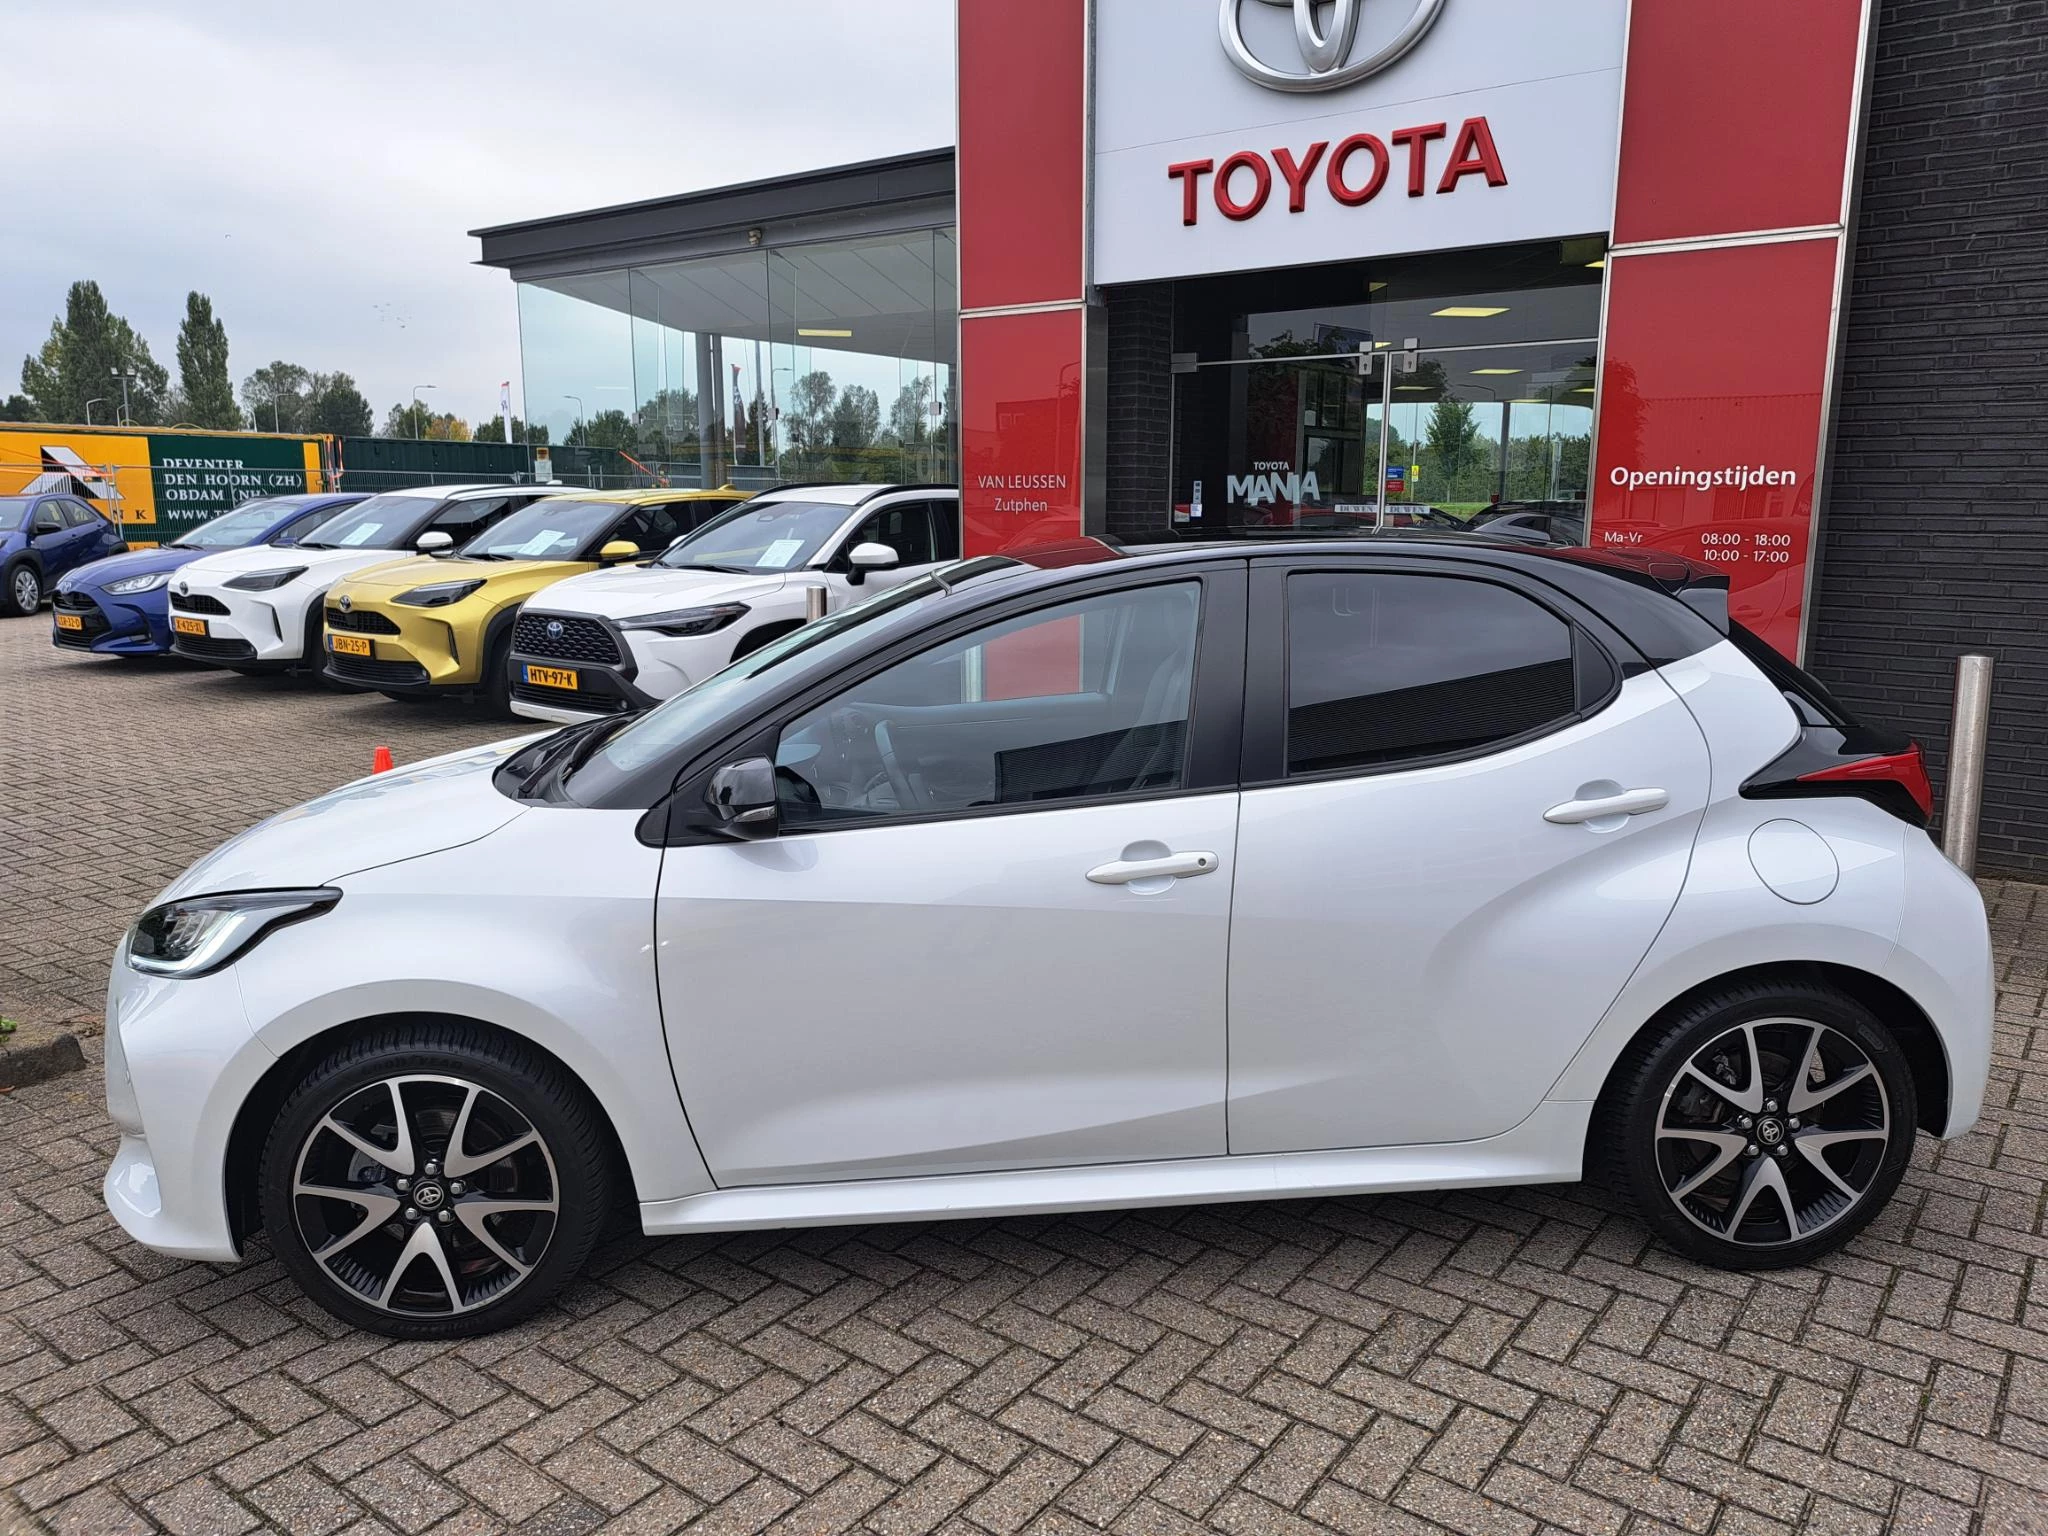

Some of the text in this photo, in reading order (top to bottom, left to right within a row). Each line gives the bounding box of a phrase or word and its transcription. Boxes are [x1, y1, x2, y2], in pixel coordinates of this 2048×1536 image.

[1168, 116, 1508, 226] TOYOTA
[163, 458, 243, 470] DEVENTER
[1253, 461, 1290, 471] TOYOTA
[165, 473, 302, 488] DEN HOORN (ZH)
[978, 475, 1066, 489] VAN LEUSSEN
[1610, 465, 1796, 491] Openingstijden
[166, 489, 224, 501] OBDAM
[1226, 471, 1320, 506] MANIA
[994, 497, 1048, 514] Zutphen
[167, 510, 229, 520] WWW.T
[1604, 531, 1643, 544] Ma-Vr
[1701, 533, 1741, 545] 08:00
[1754, 534, 1791, 546] 18:00
[1703, 549, 1739, 561] 10:00
[1753, 550, 1789, 563] 17:00
[176, 619, 205, 633] X-425-XL
[334, 637, 367, 651] JBN-25-P
[530, 670, 574, 687] HTV-97-K
